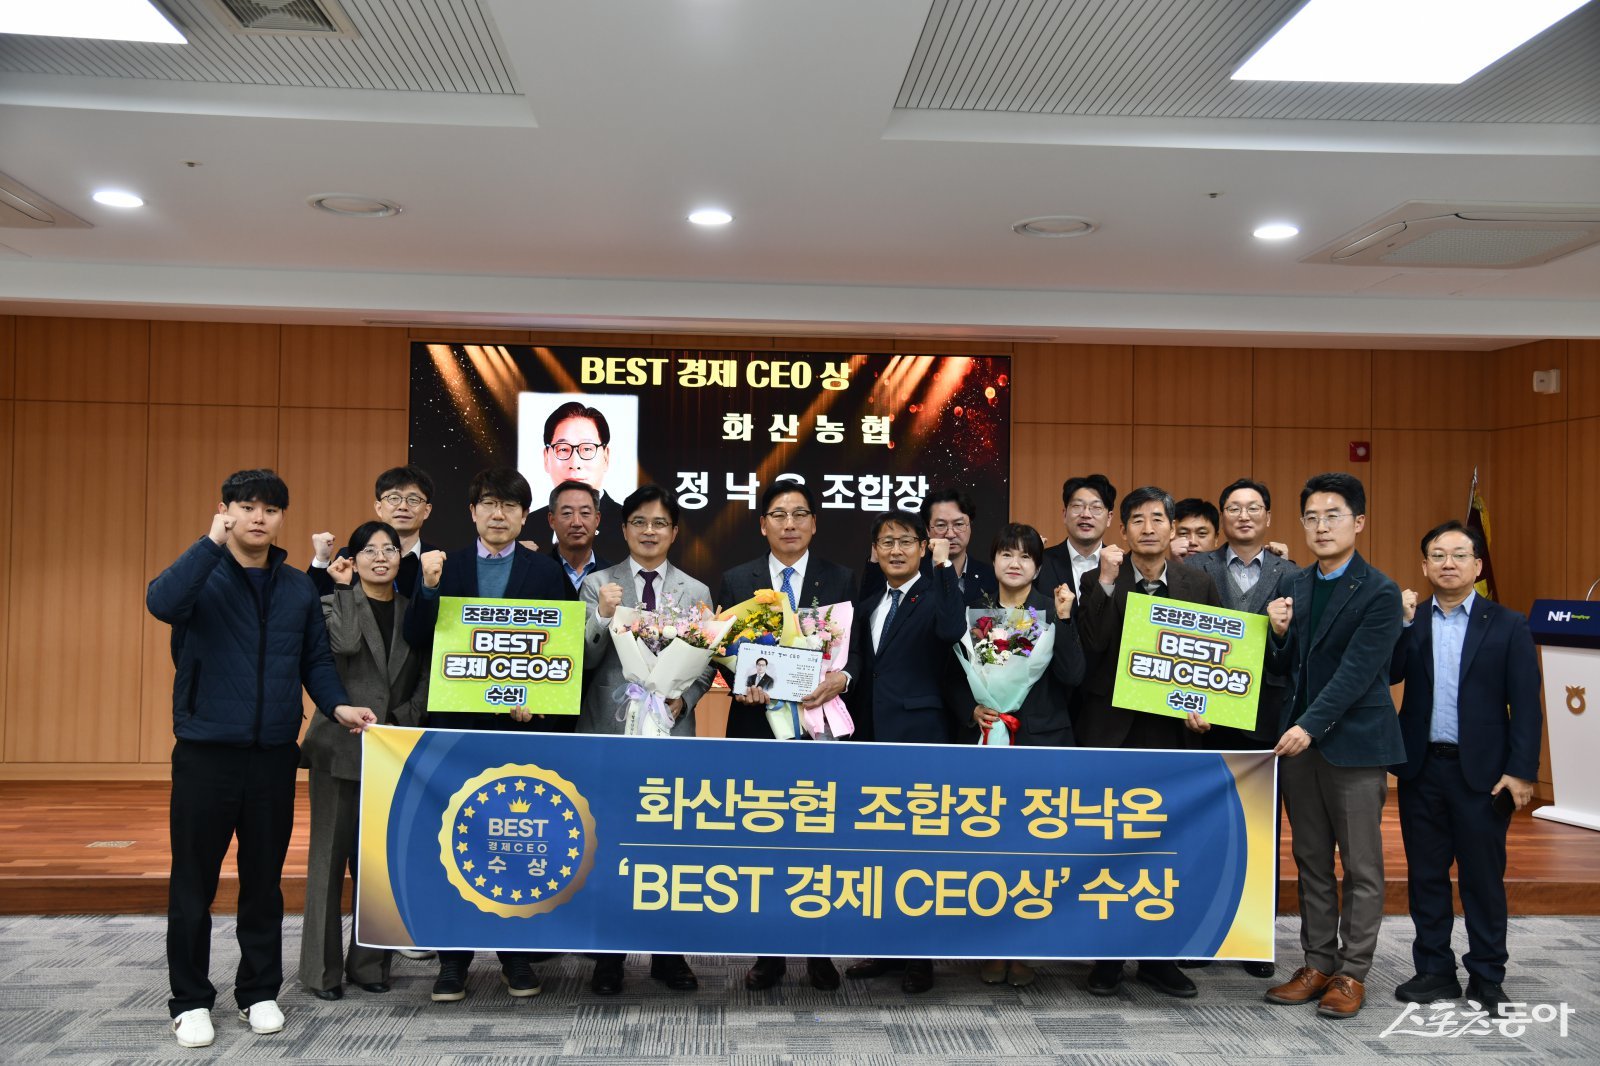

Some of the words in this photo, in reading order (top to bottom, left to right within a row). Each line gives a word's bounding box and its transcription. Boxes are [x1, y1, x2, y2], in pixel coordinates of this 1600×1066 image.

[581, 356, 669, 386] BEST
[678, 358, 738, 388] 경제
[746, 360, 812, 389] CEO
[819, 361, 852, 391] 상
[822, 474, 929, 513] 조합장
[464, 606, 511, 623] 조합장
[512, 607, 559, 625] 정낙온
[1152, 606, 1197, 628] 조합장
[1198, 614, 1242, 636] 정낙온
[1547, 610, 1572, 622] NH
[475, 632, 545, 654] BEST
[1160, 633, 1227, 663] BEST
[446, 656, 488, 677] 경제
[1131, 654, 1172, 680] 경제
[487, 687, 524, 703] 수상!
[1169, 692, 1204, 711] 수상!
[636, 777, 837, 834] 화산농협
[854, 783, 1007, 838] 조합장
[1021, 786, 1168, 840] 정낙온
[488, 817, 549, 838] BEST
[784, 864, 883, 919] 경제
[1078, 867, 1180, 921] 수상
